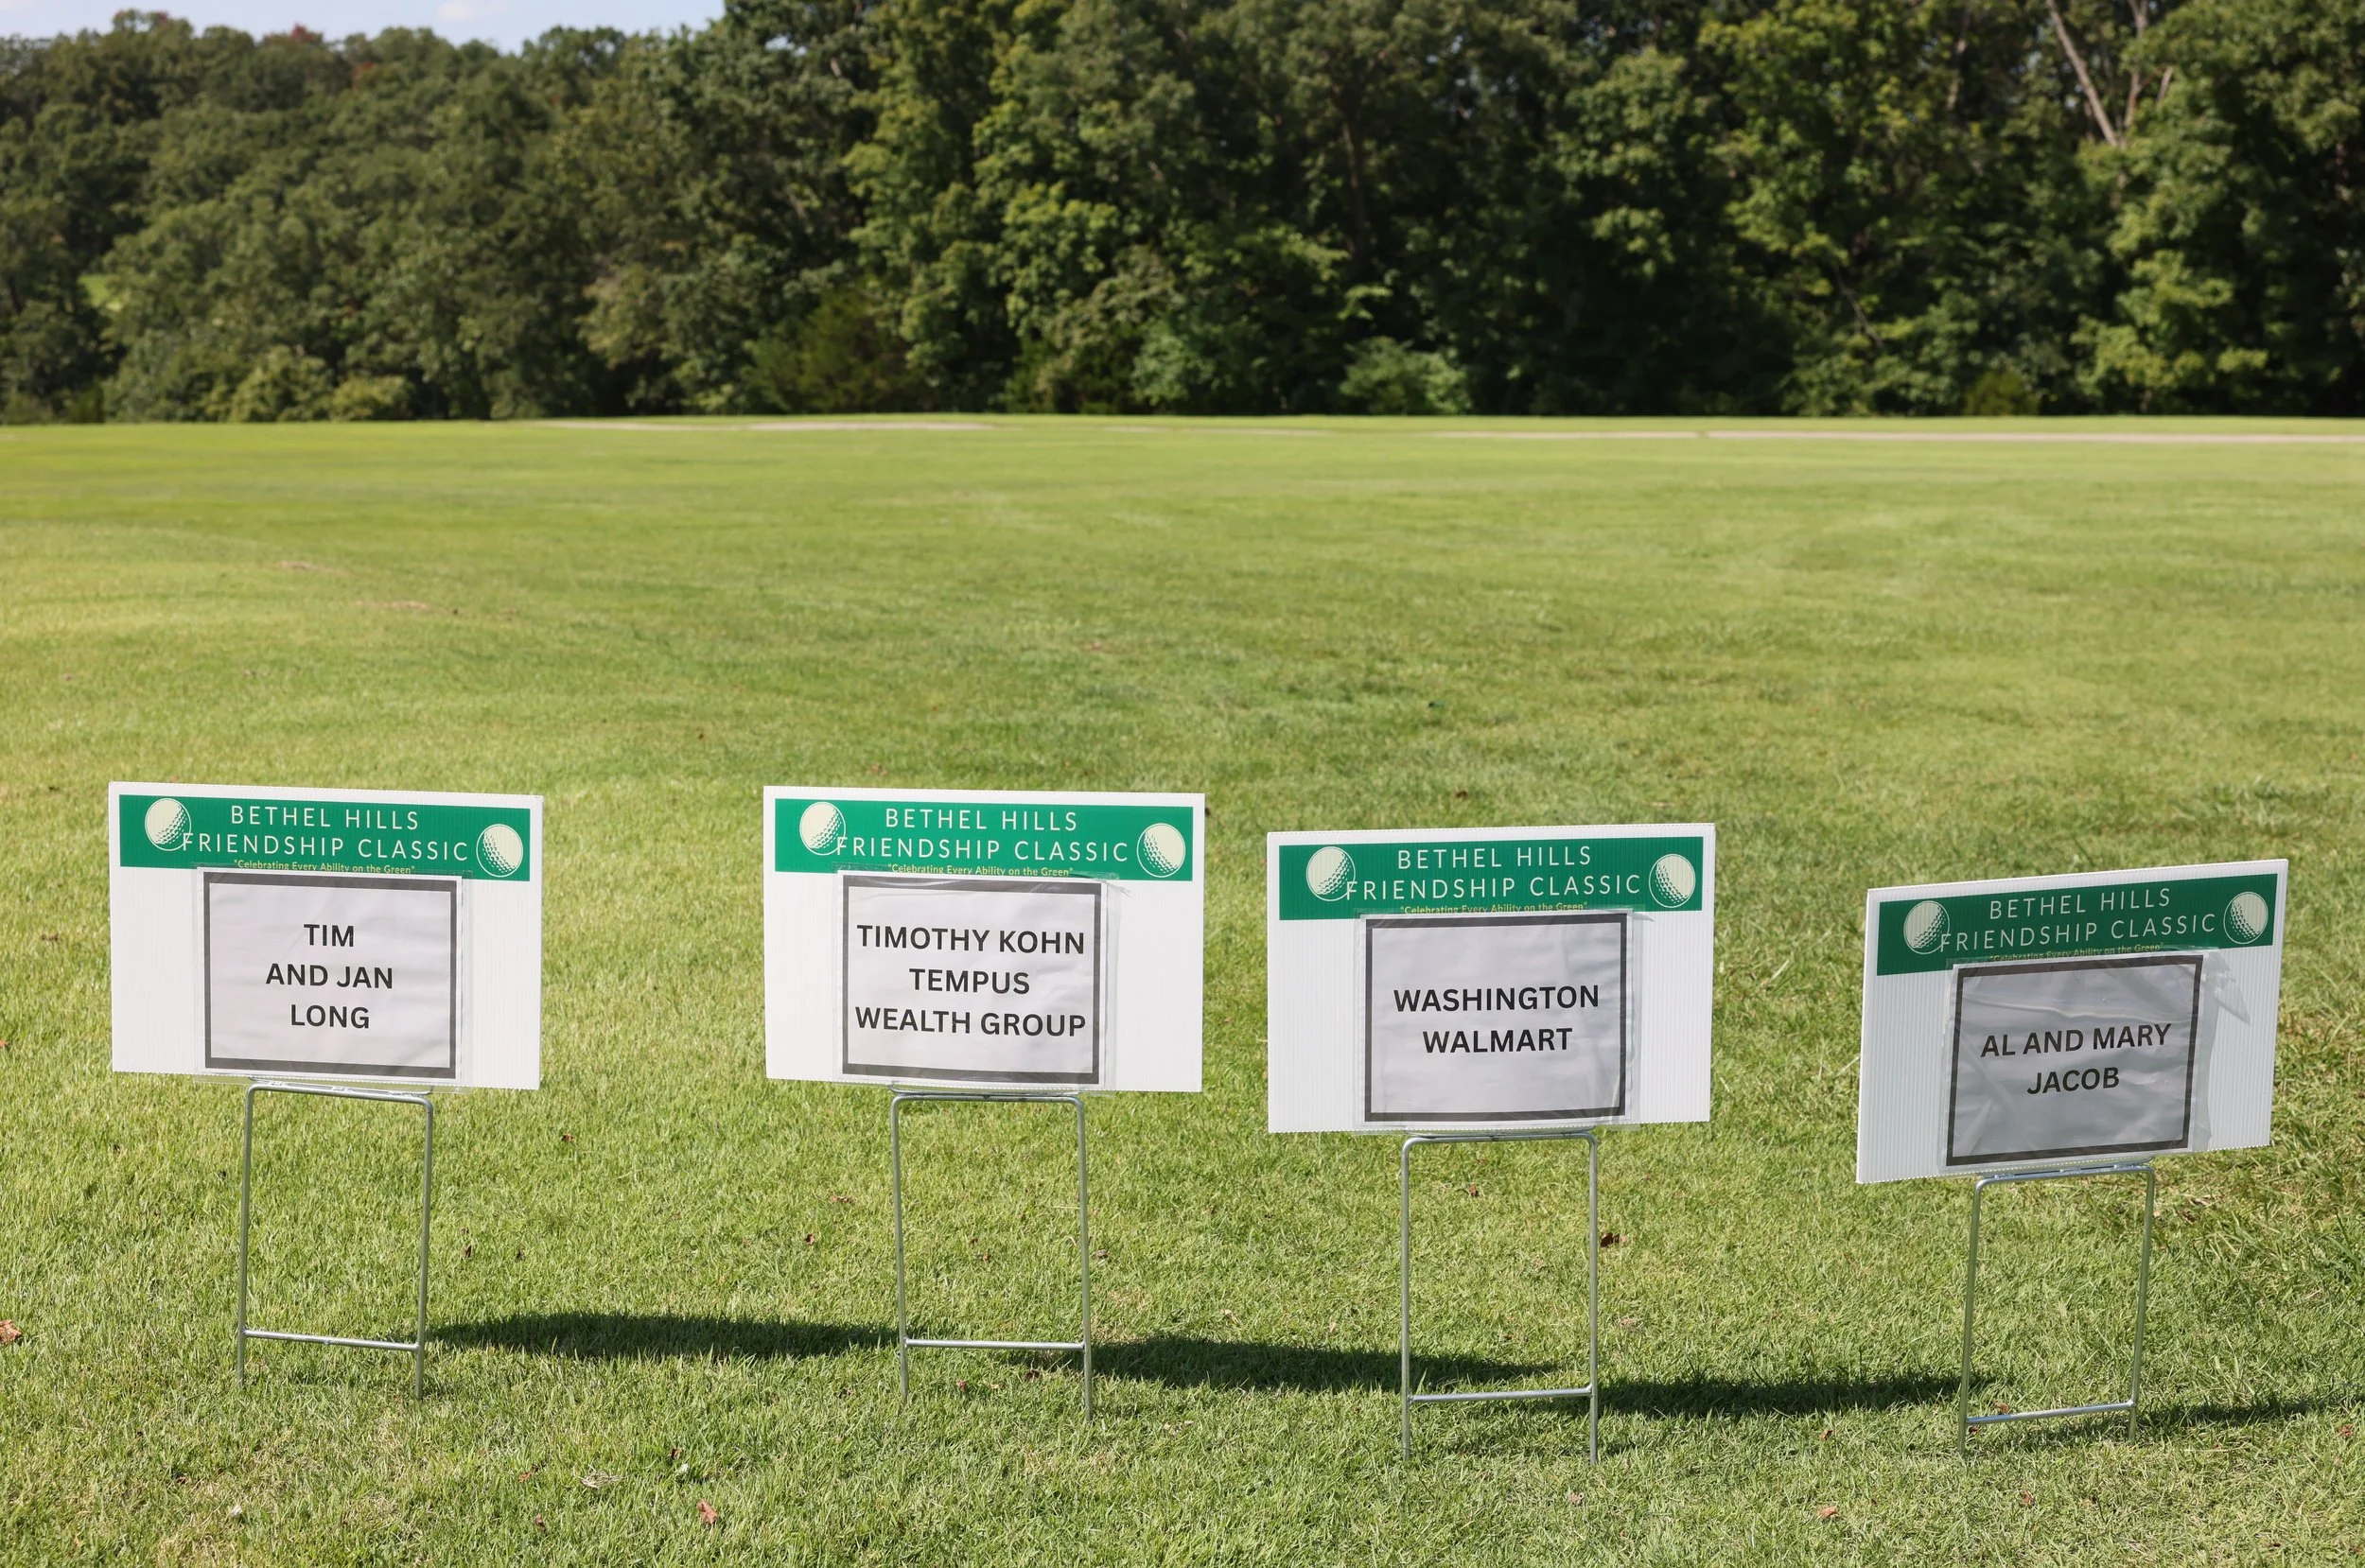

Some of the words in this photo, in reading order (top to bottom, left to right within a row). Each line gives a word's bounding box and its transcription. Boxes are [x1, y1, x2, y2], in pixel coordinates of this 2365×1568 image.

[231, 805, 331, 828] BETHEL
[345, 810, 418, 830] HILLS
[885, 808, 987, 829] BETHEL
[1003, 811, 1077, 831] HILLS
[183, 833, 343, 857] FRIENDSHIP
[359, 839, 467, 862] CLASSIC
[837, 836, 999, 859] FRIENDSHIP
[1014, 841, 1128, 862] CLASSIC
[1398, 848, 1502, 870] BETHEL
[1517, 845, 1590, 866] HILLS
[321, 862, 349, 872] Ability
[366, 864, 380, 873] the
[975, 866, 1006, 876] Ability
[1024, 867, 1038, 876] the
[1346, 878, 1515, 900] FRIENDSHIP
[1531, 874, 1640, 896] CLASSIC
[1989, 895, 2086, 919] BETHEL
[2101, 888, 2170, 911] HILLS
[304, 924, 354, 947] TIM
[857, 925, 990, 951] TIMOTHY
[999, 931, 1083, 954] KOHN
[1940, 922, 2097, 952] FRIENDSHIP
[2111, 913, 2216, 938] CLASSIC
[266, 963, 328, 985] AND
[337, 967, 393, 988] JAN
[909, 968, 1029, 994] TEMPUS
[1393, 985, 1599, 1011] WASHINGTON
[290, 1004, 369, 1028] LONG
[855, 1006, 970, 1033] WEALTH
[981, 1013, 1085, 1037] GROUP
[1423, 1028, 1572, 1053] WALMART
[1981, 1035, 2015, 1057] AL
[2023, 1029, 2083, 1054] AND
[2093, 1023, 2171, 1050] MARY
[2027, 1067, 2119, 1094] JACOB
